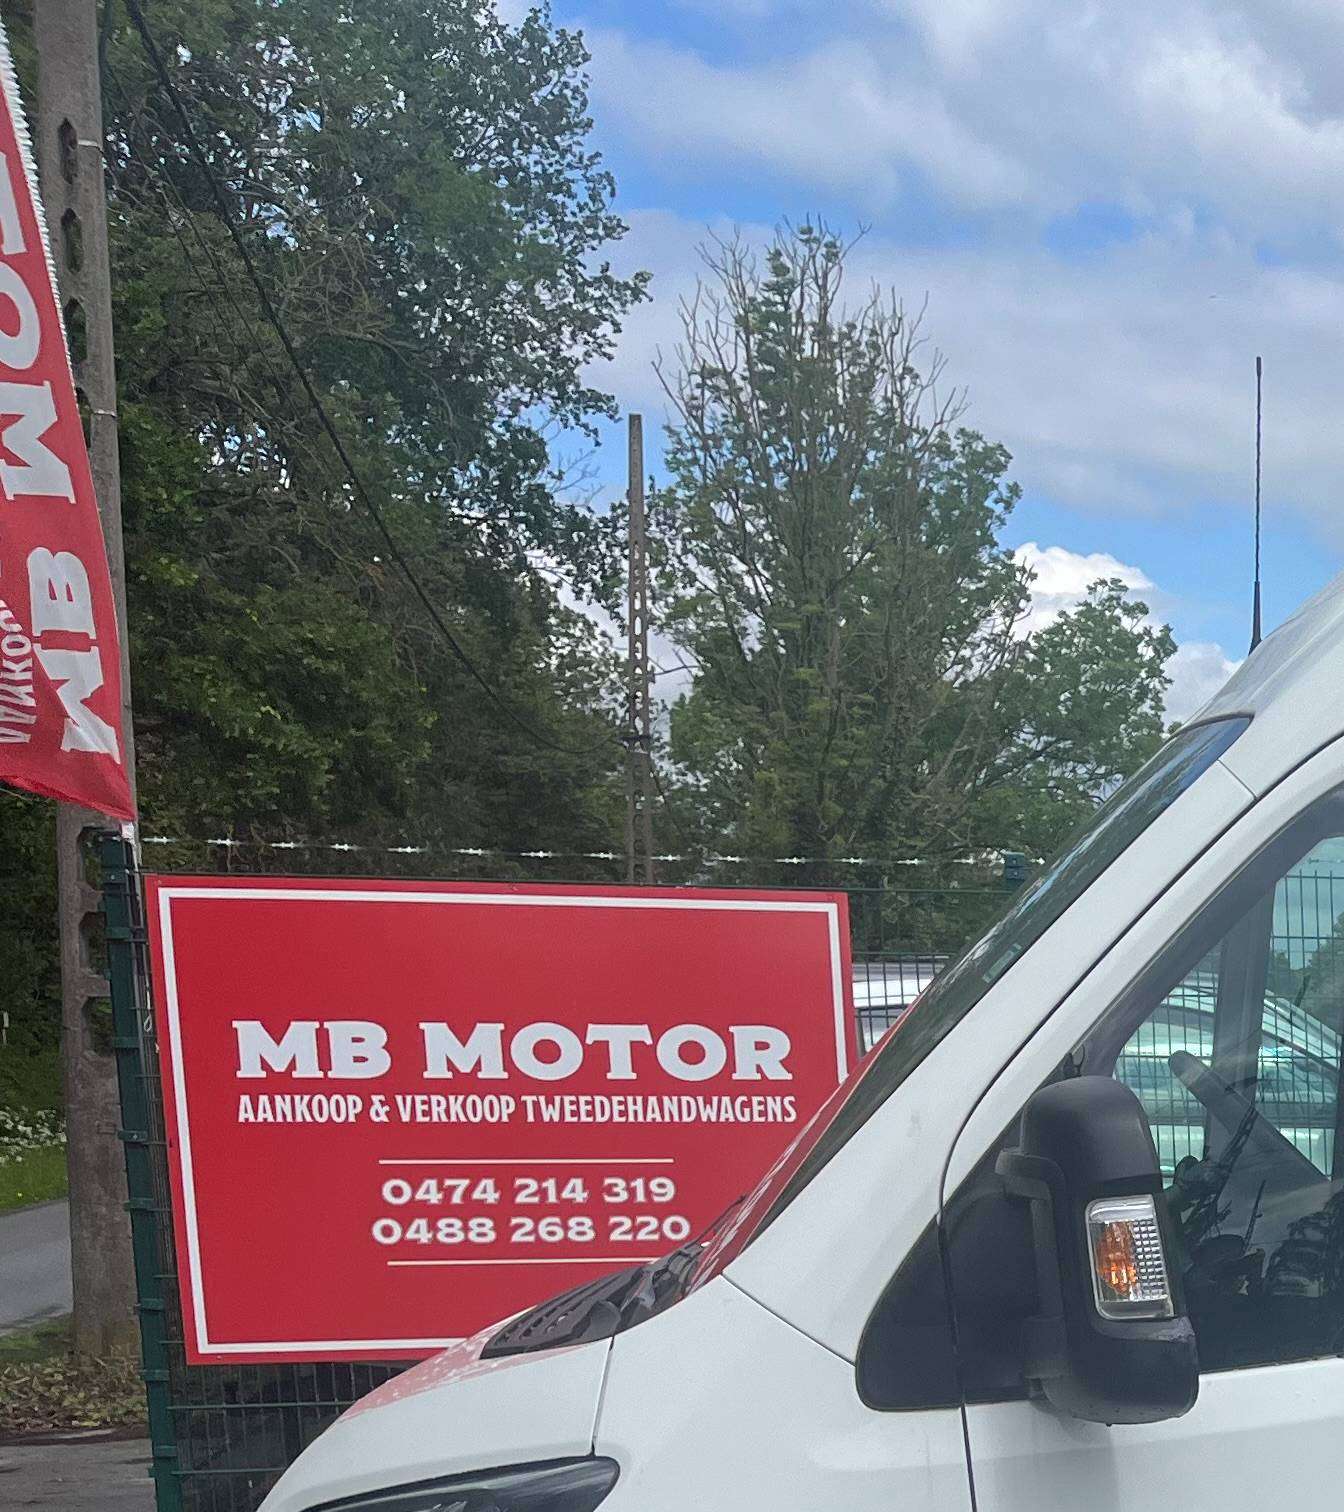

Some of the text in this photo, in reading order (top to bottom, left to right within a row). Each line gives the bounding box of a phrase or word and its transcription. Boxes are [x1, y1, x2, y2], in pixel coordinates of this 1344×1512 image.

[231, 1020, 793, 1082] MB MOTOR
[238, 1093, 797, 1123] AANKOOP & VERKOOP TWEEDEHANDWAGENS
[381, 1176, 676, 1205] 0474 214 319
[372, 1215, 692, 1245] 0488 268 220
